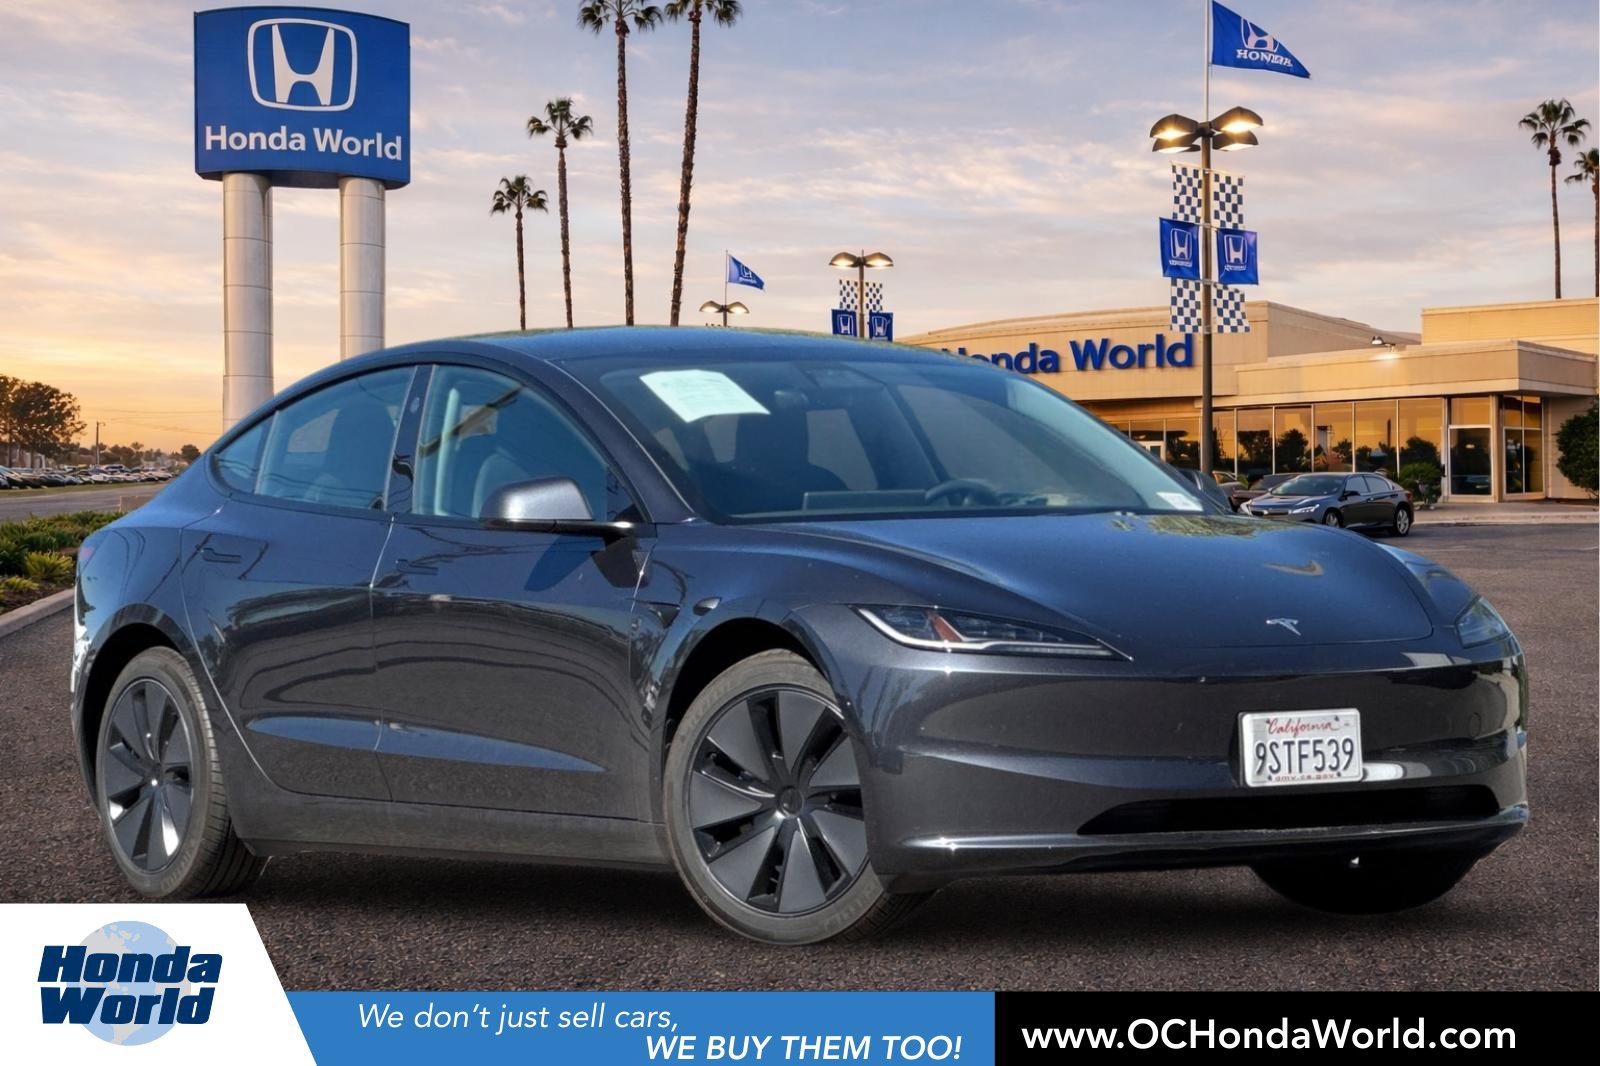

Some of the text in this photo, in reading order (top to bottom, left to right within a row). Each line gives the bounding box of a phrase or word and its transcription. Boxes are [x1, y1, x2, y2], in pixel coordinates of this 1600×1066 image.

[205, 125, 402, 161] Honda World
[941, 333, 1194, 374] nda World
[1267, 718, 1340, 737] California
[1255, 737, 1354, 775] 9STF539
